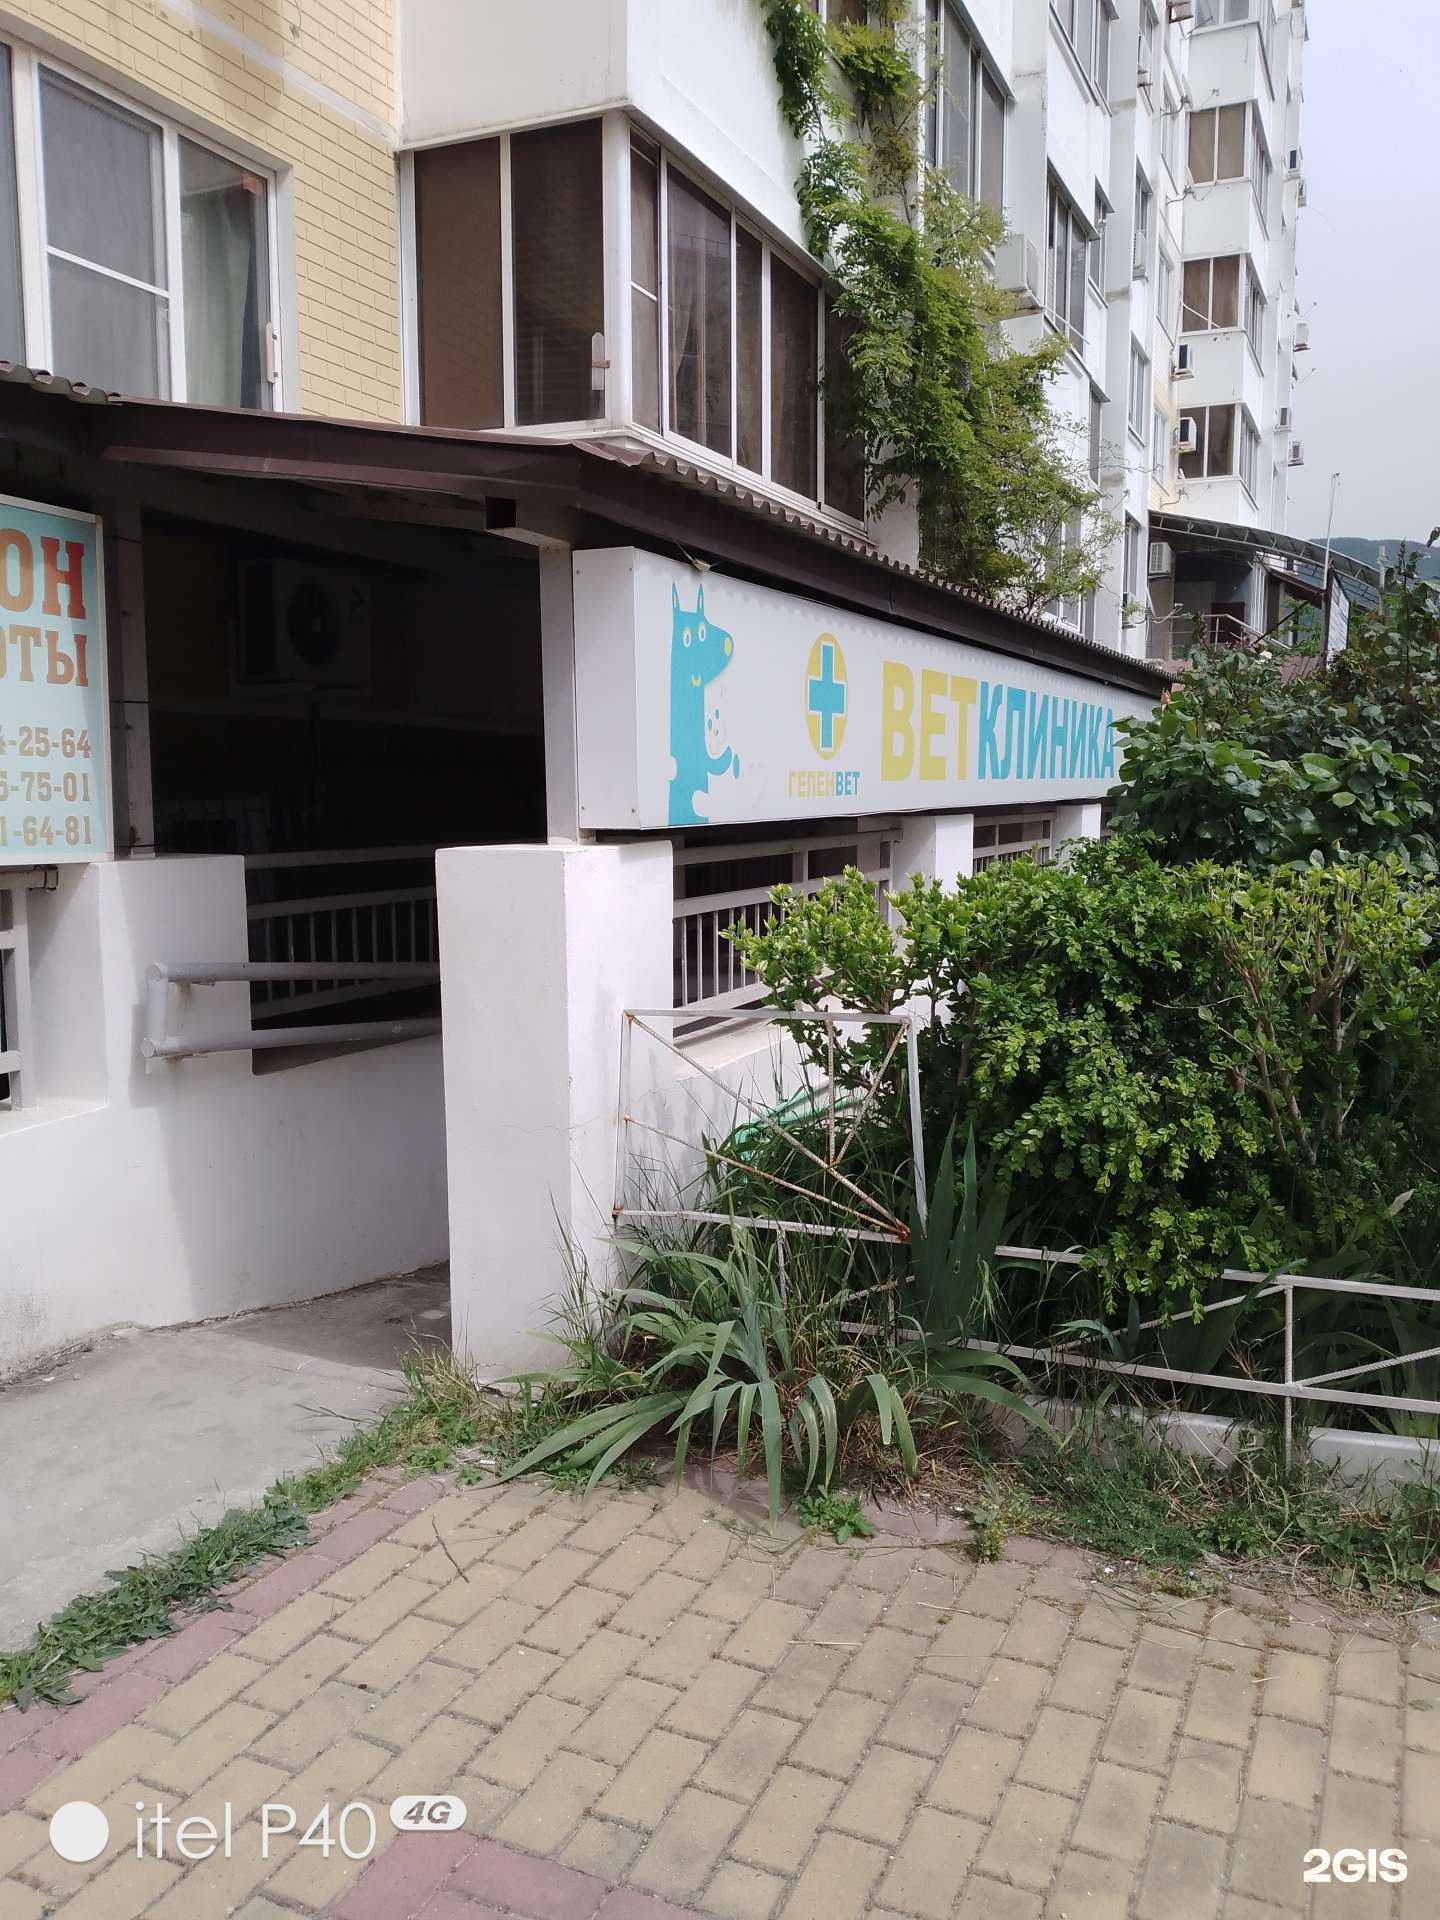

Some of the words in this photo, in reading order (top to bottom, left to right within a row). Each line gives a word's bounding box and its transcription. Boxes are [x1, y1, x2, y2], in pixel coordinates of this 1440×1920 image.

[0, 623, 89, 688] ТЫ
[880, 660, 1115, 782] ВЕТКЛИНИКА
[787, 769, 861, 800] ГЕЛЕНВЕТ
